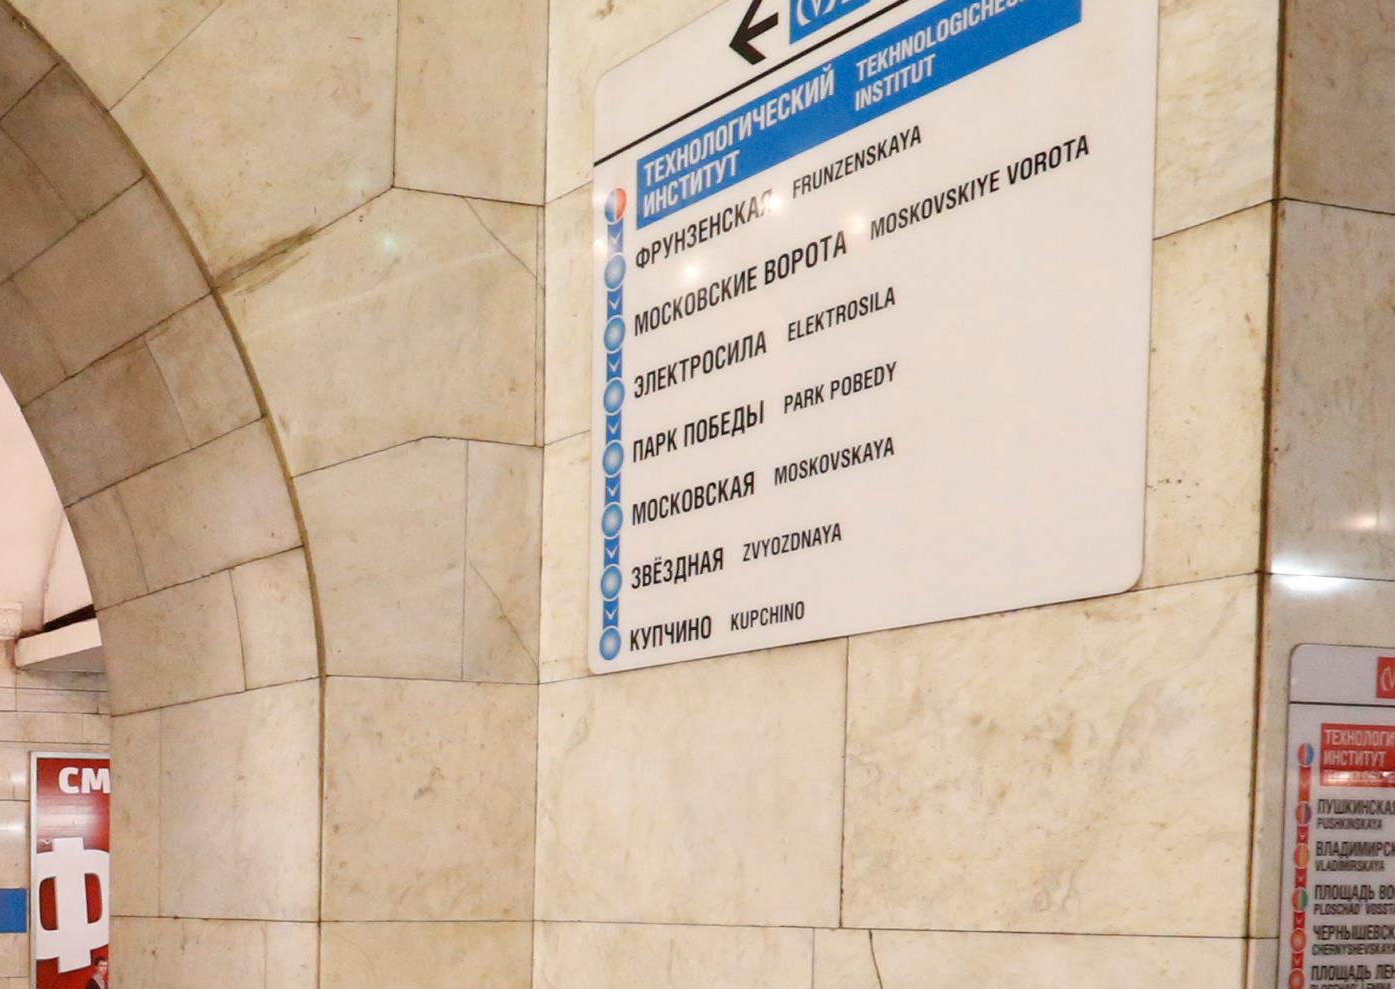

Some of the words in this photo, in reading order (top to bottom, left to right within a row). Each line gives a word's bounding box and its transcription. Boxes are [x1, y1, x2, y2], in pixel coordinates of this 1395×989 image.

[855, 0, 1024, 81] TEKHNOLOGICHE
[855, 54, 937, 111] INSTITUT
[643, 63, 835, 186] ТЕХНОЛОГИЧЕСКИЙ
[643, 149, 740, 218] ИНСТИТУТ
[792, 125, 922, 199] FRUNZENSKAYA
[870, 169, 1001, 241] MOSKOVSKIYE
[1007, 134, 1090, 186] VOROTA
[634, 265, 758, 337] МОСКОВСКИЕ
[764, 230, 847, 285] ВОРОТА
[787, 287, 896, 342] ELEKTROSILA
[634, 331, 768, 398] ЭЛЕКТРОСИЛА
[784, 384, 825, 414] PARK
[830, 361, 898, 399] POBEDY
[632, 426, 679, 463] ПАРК
[683, 399, 765, 448] ПОБЕДЫ
[773, 436, 895, 486] MOSKOVSKAYA
[631, 471, 755, 526] МОСКОВСКАЯ
[631, 547, 724, 589] ЗВЁЗДНАЯ
[742, 522, 842, 563] ZVYOZDNAYA
[629, 614, 712, 652] КУПЧИНО
[730, 600, 805, 632] KUPCHINO
[1323, 750, 1387, 767] ИНСТИТУТ
[1314, 884, 1375, 902] ПЛОЩАДЬ
[1310, 965, 1371, 982] ПЛОЩАДЬ
